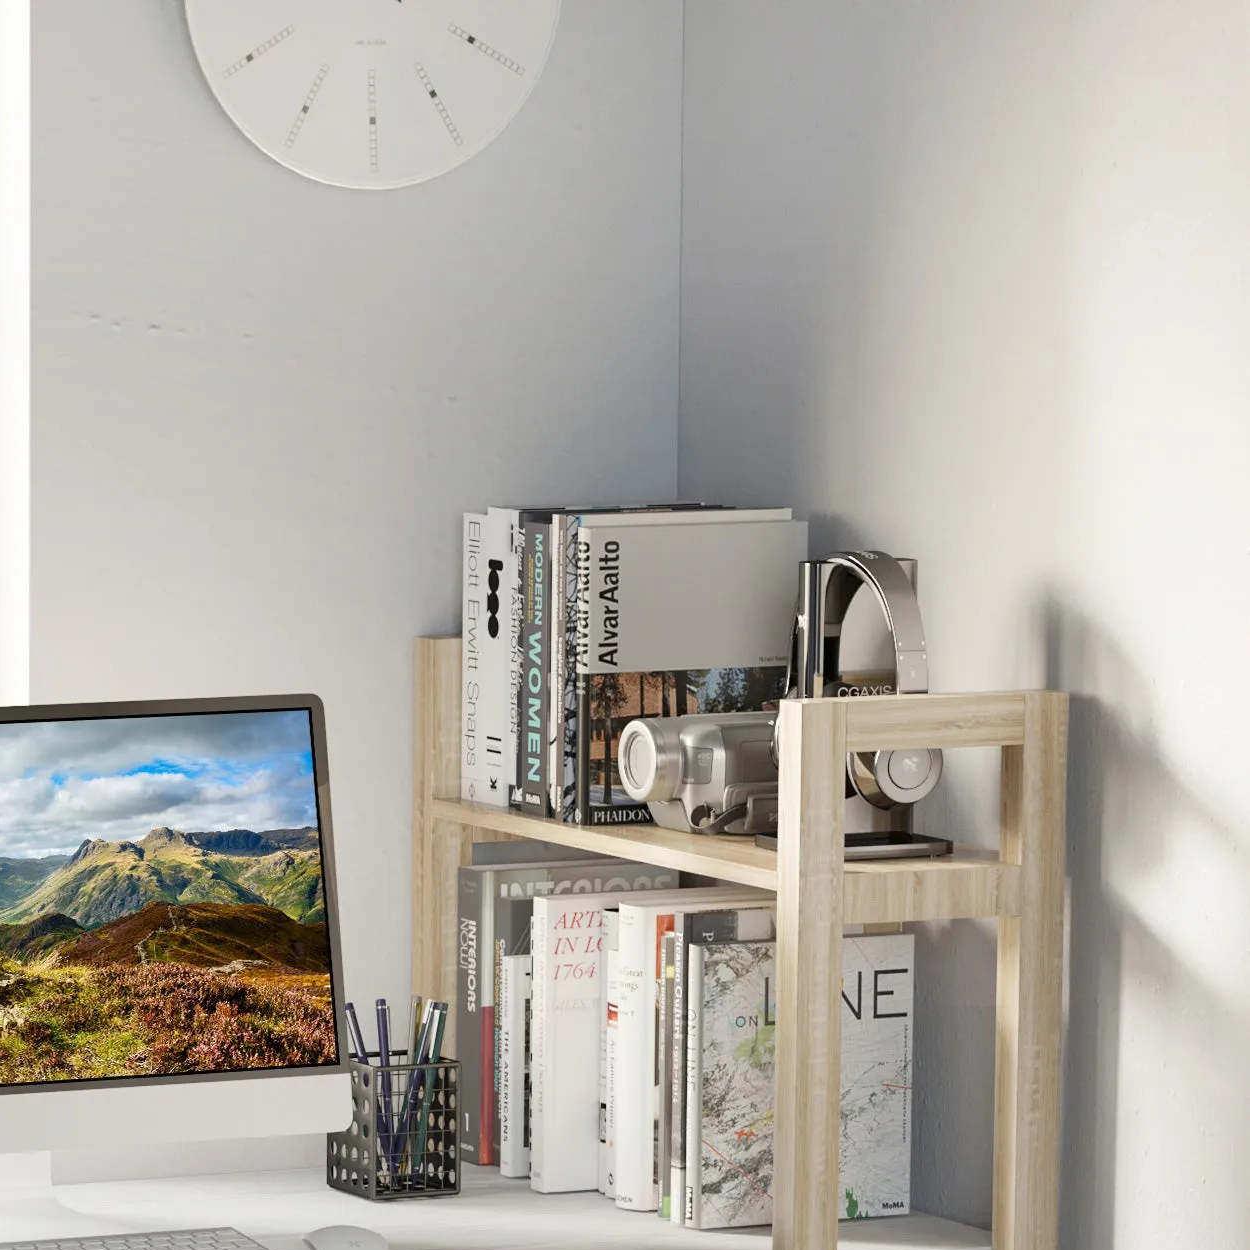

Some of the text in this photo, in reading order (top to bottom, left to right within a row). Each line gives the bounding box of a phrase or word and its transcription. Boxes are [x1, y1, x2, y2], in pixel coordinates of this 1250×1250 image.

[534, 533, 544, 626] MODERN
[598, 540, 620, 667] Alvar Aalto
[464, 521, 481, 766] Elliott Erwitt Snaps
[510, 587, 518, 734] FASHION DESIGN
[527, 631, 543, 782] WOMEN
[593, 808, 651, 823] PHAIDON
[467, 920, 477, 1012] INTERIORS
[553, 961, 597, 980] 1764
[554, 936, 579, 955] IN
[675, 931, 684, 981] Picasso
[674, 984, 683, 1039] Guitars
[735, 1014, 758, 1028] ON
[881, 1202, 905, 1211] MoMA
